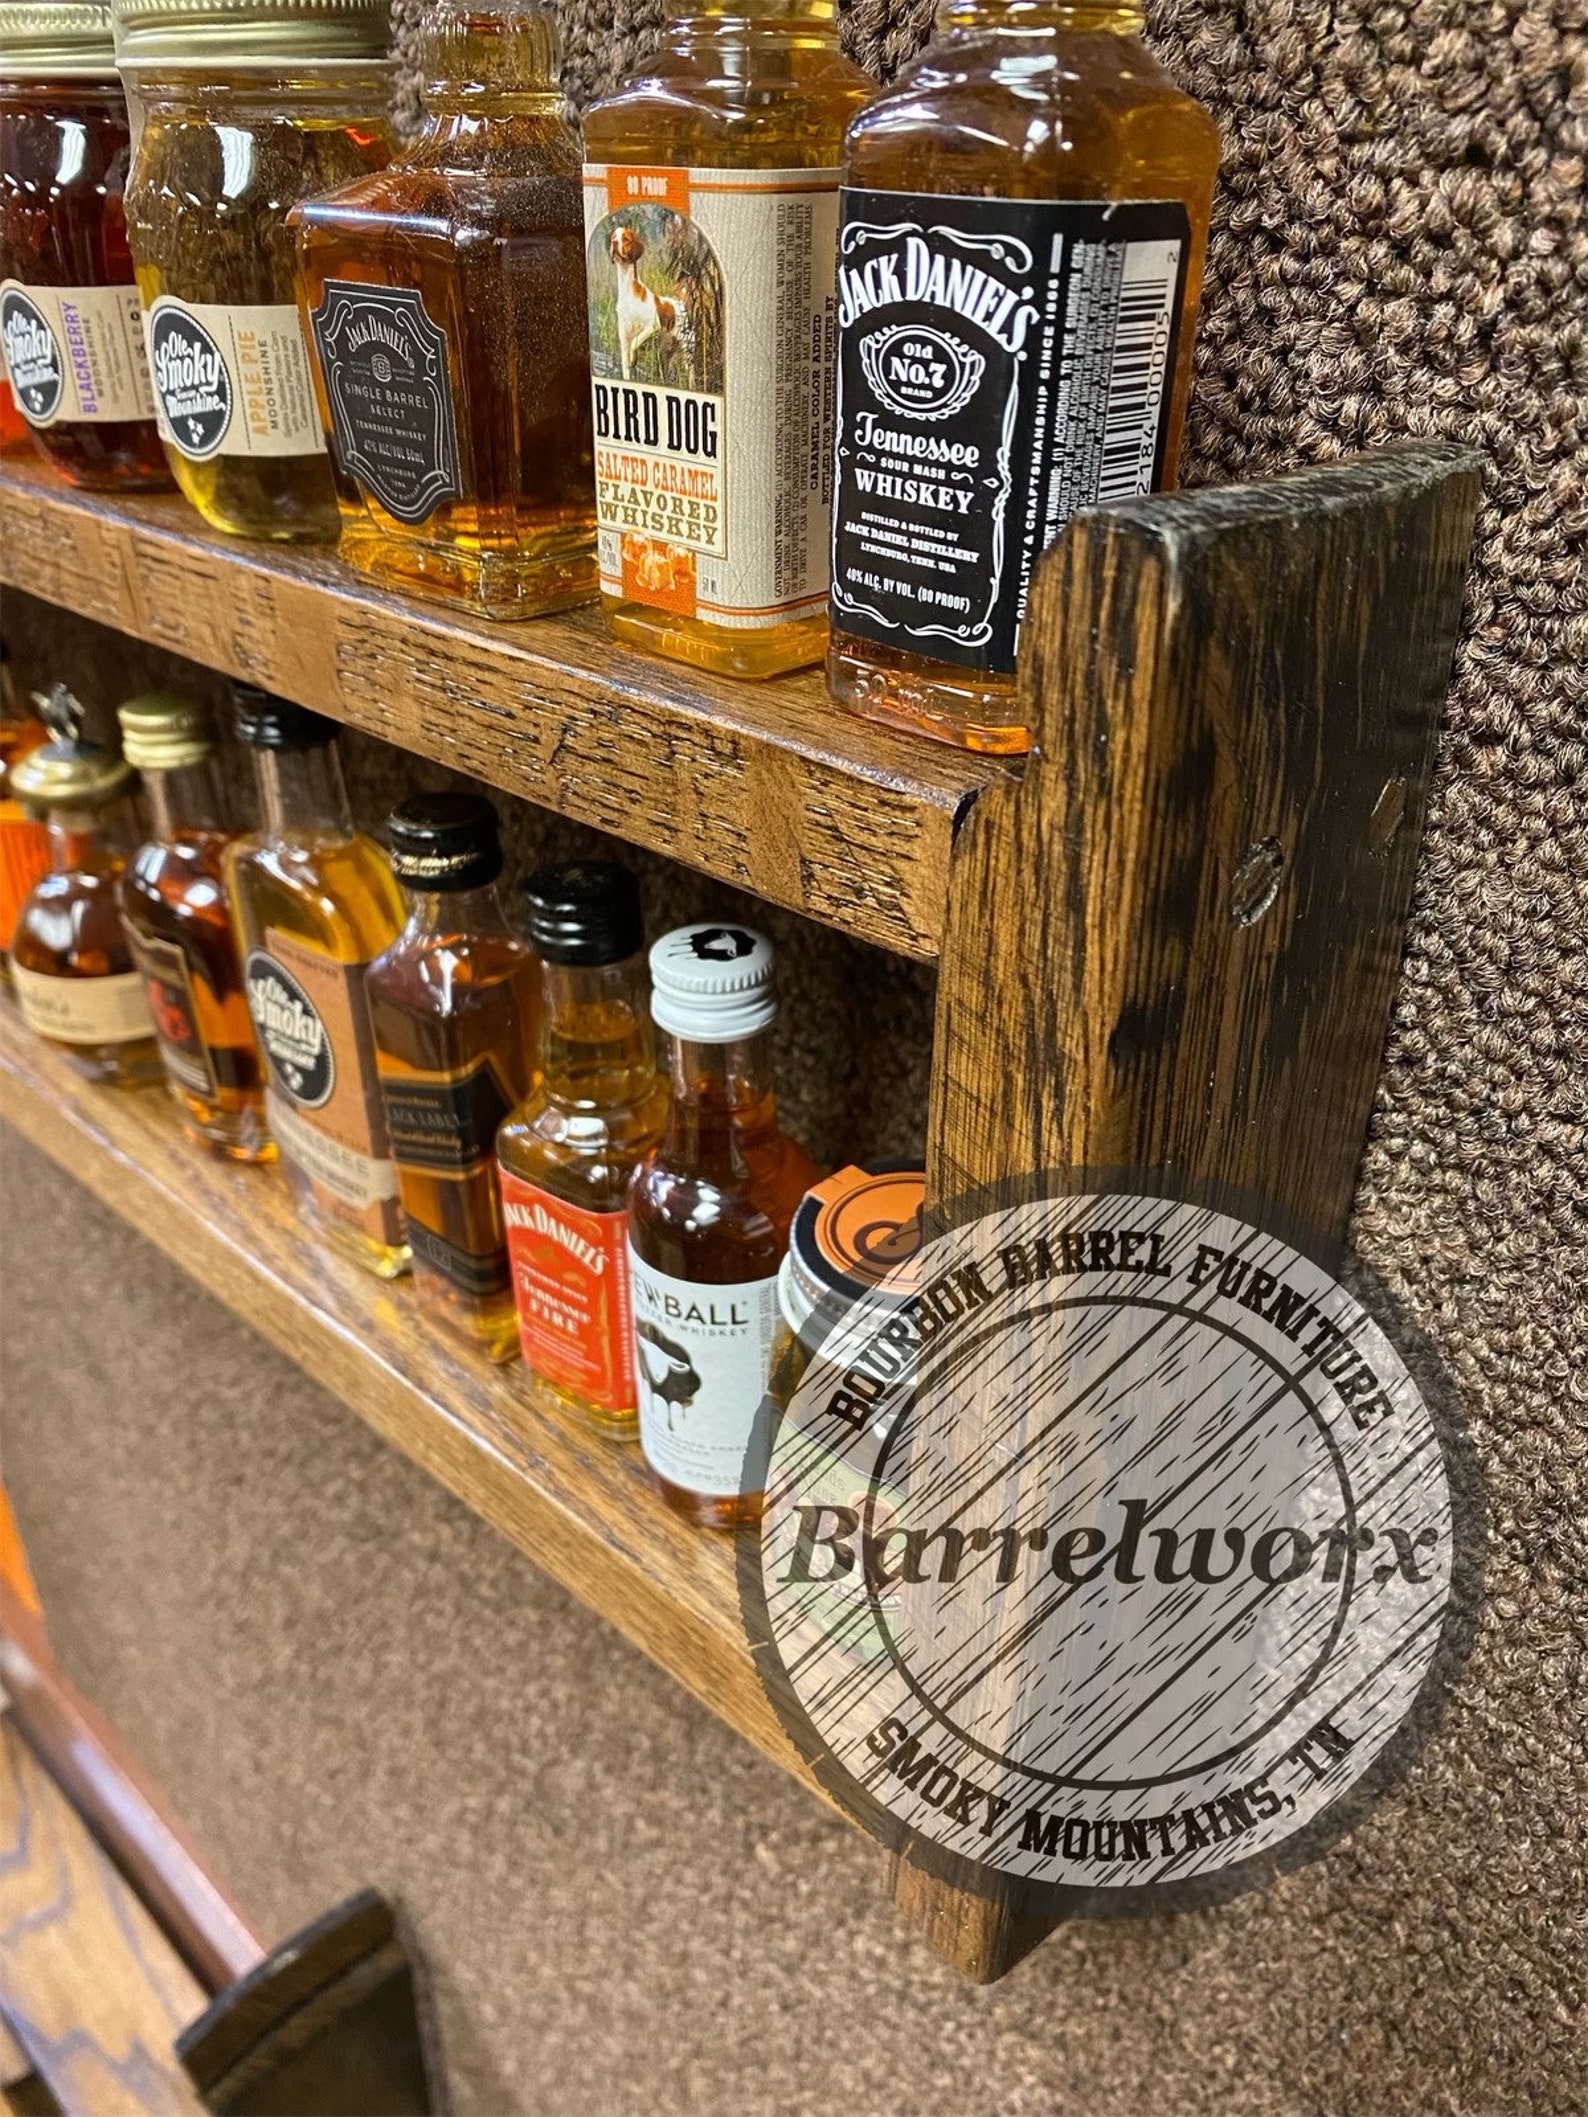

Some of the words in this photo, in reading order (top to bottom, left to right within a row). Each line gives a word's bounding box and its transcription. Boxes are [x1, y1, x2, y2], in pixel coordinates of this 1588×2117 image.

[776, 204, 785, 245] SHOULD
[776, 249, 785, 288] WOMEN
[825, 296, 833, 311] BY
[838, 253, 904, 328] JACK
[904, 237, 1040, 352] DANIEL'S
[1065, 273, 1082, 328] SURGEON
[62, 302, 98, 414] BLACKBERRY
[168, 331, 194, 358] Ole
[237, 330, 258, 365] PIE
[812, 315, 821, 363] ADDED
[825, 316, 833, 363] SPIRITS
[902, 342, 933, 359] Old
[1062, 333, 1076, 356] THE
[1147, 311, 1170, 407] 00005
[155, 342, 221, 393] Smoky
[776, 340, 784, 384] SURGEON
[1060, 360, 1073, 375] TO
[244, 373, 269, 436] APPLE
[258, 339, 278, 430] MOONSHINE
[344, 382, 381, 400] SINGLE
[385, 390, 429, 409] BARREL
[812, 369, 820, 417] COLOR
[823, 367, 831, 423] WESTERN
[901, 386, 933, 398] BRAND
[1069, 358, 1084, 416] ALCOHOLIC
[1098, 390, 1107, 412] MAY
[370, 404, 405, 419] SELECT
[595, 384, 658, 447] BIRD
[666, 395, 718, 459] DOG
[1025, 385, 1048, 530] CRAFTSMANSHIP
[1039, 326, 1055, 379] SINCE
[1053, 380, 1071, 443] ACCORDING
[1095, 416, 1104, 437] AND
[811, 422, 819, 490] CARAMEL
[854, 411, 980, 467] Tennessee
[1065, 420, 1077, 452] DRINK
[597, 450, 649, 487] SALTED
[653, 460, 718, 502] CARAMEL
[822, 454, 830, 504] BOTTLED
[880, 457, 909, 472] SOUR
[913, 464, 946, 480] MASH
[1062, 457, 1074, 476] NOT
[598, 480, 718, 524] FLAVORED
[854, 468, 974, 514] WHISKEY
[1058, 480, 1071, 520] SHOULD
[599, 500, 718, 545] WHISKEY
[844, 521, 870, 537] JACK
[871, 528, 909, 547] DANIEL
[911, 538, 980, 563] DISTILLERY
[861, 511, 900, 528] DISTILLED
[909, 523, 945, 539] BOTTLED
[946, 532, 959, 541] BY
[774, 540, 783, 598] GOVERNMENT
[938, 561, 956, 574] USA
[846, 567, 863, 583] 40%
[883, 577, 895, 593] BY
[896, 581, 916, 598] VOL.
[935, 591, 970, 614] PROOF)
[534, 1203, 609, 1276] DANIEL'S
[530, 1298, 580, 1335] FIRE
[679, 1325, 748, 1337] WHISKEY
